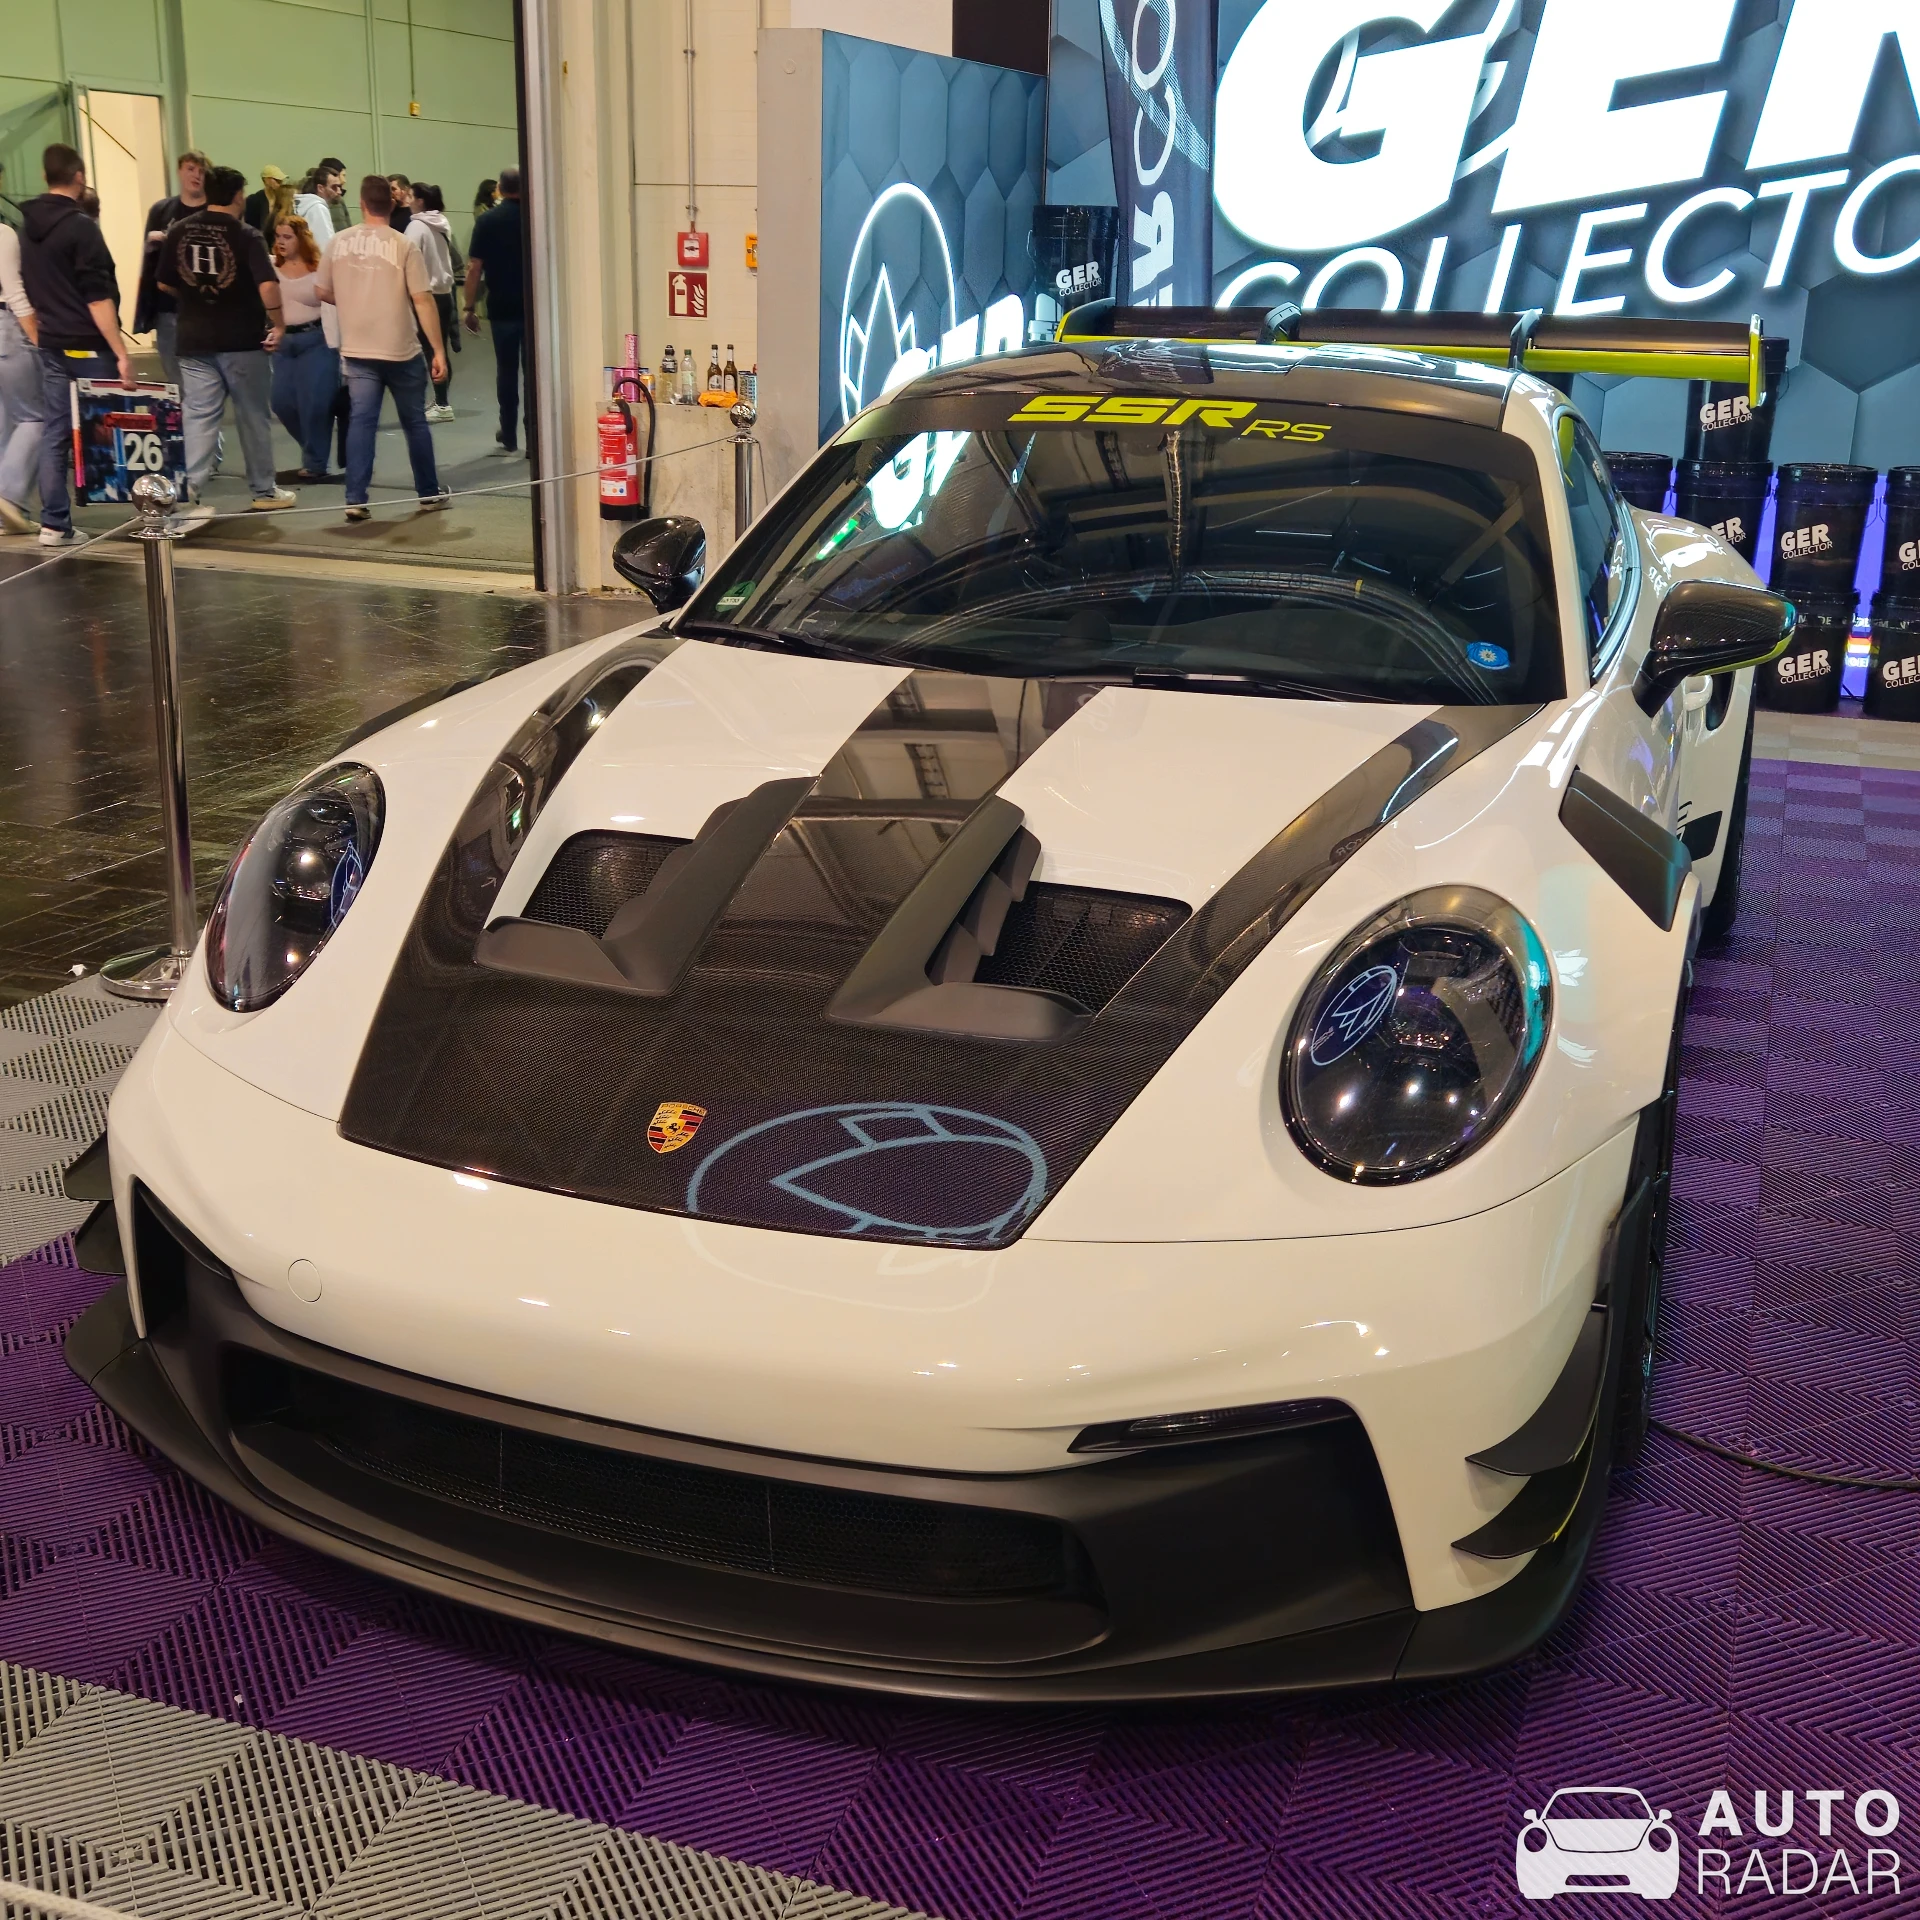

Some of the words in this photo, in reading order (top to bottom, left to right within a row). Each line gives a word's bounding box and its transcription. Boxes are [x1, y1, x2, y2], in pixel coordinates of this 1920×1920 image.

[1056, 261, 1100, 289] GER
[1059, 278, 1102, 297] COLLECTOR
[1007, 395, 1257, 428] SSR
[1240, 419, 1332, 442] RS
[1700, 395, 1750, 424] GER
[1701, 412, 1753, 432] COLLECTOR
[124, 432, 164, 472] 26
[1711, 516, 1745, 541] ER
[1781, 523, 1831, 552] GER
[1782, 541, 1833, 560] COLLECTOR
[1777, 649, 1829, 677] GER
[1780, 665, 1832, 685] COLLECTOR
[1882, 654, 1920, 681] GE
